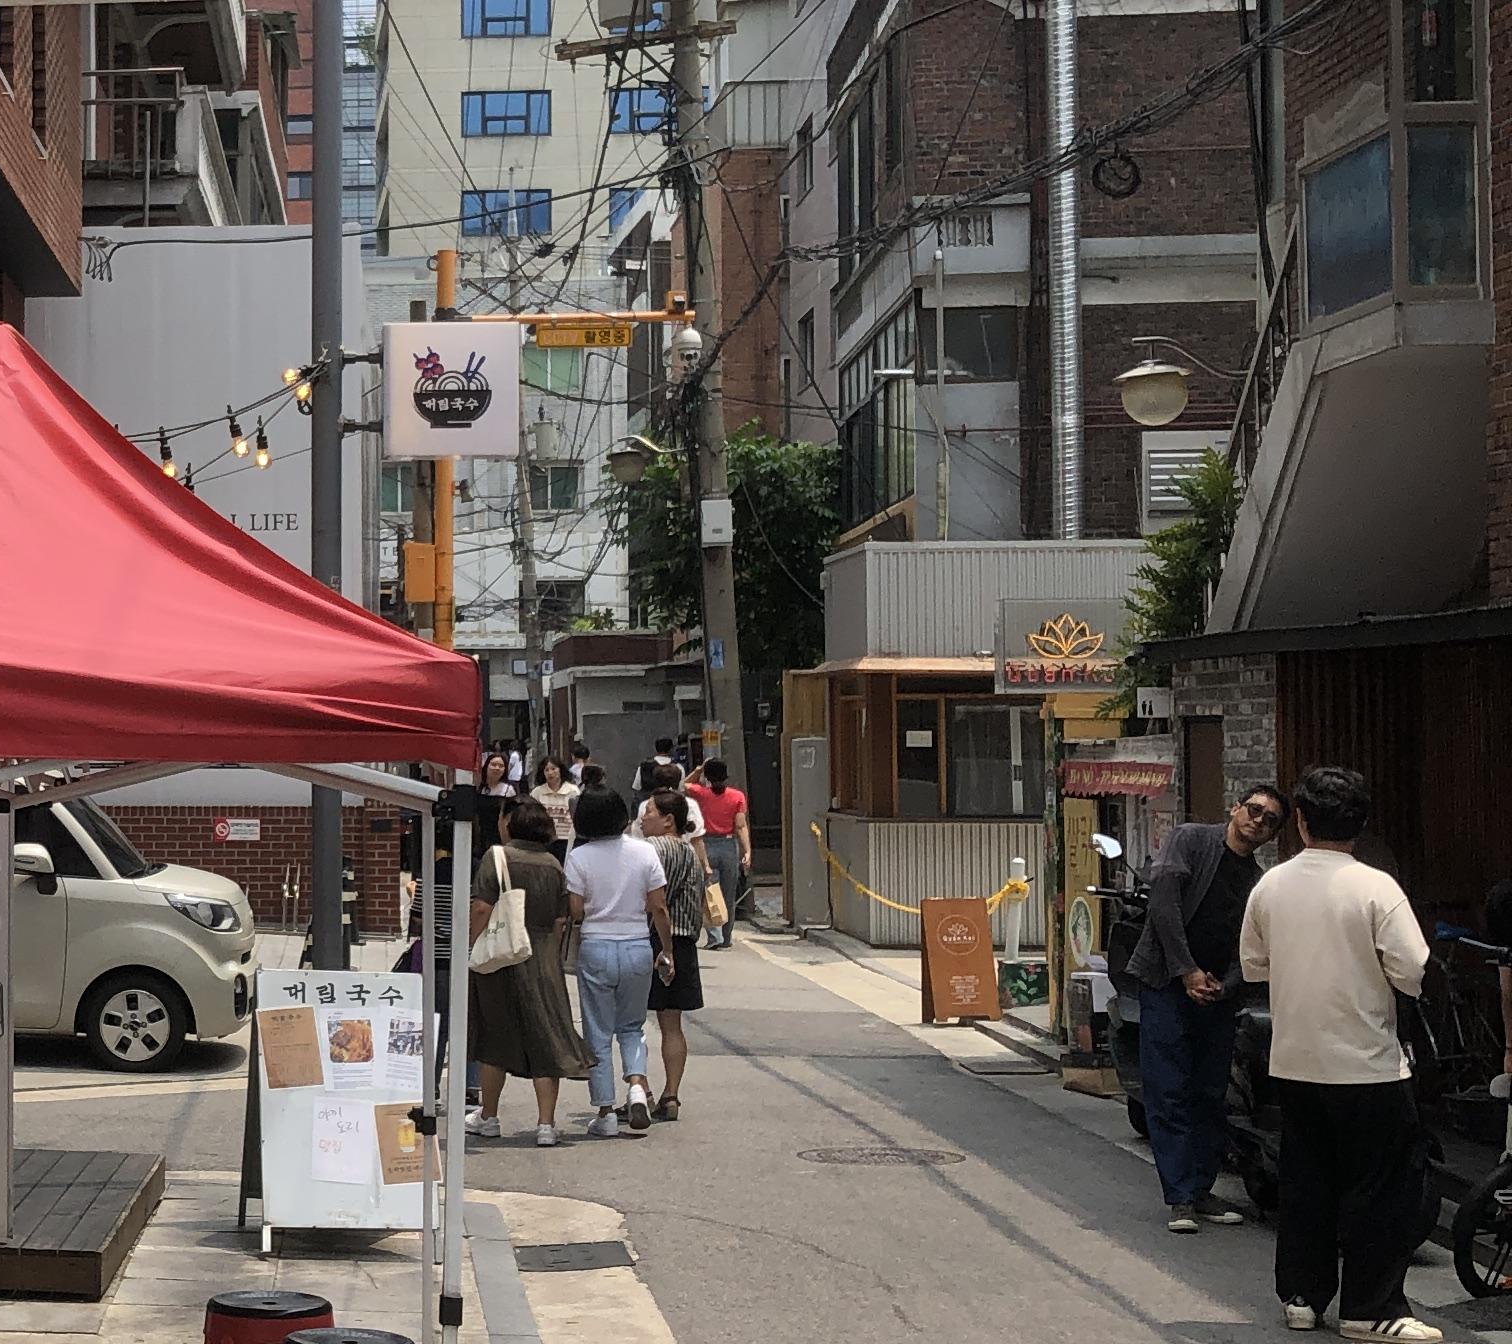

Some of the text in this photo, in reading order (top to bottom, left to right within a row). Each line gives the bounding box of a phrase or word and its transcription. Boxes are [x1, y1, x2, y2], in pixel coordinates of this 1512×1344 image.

[584, 330, 626, 344] 촬영중
[249, 513, 299, 531] LIFE
[282, 981, 404, 1007] 대림국수
